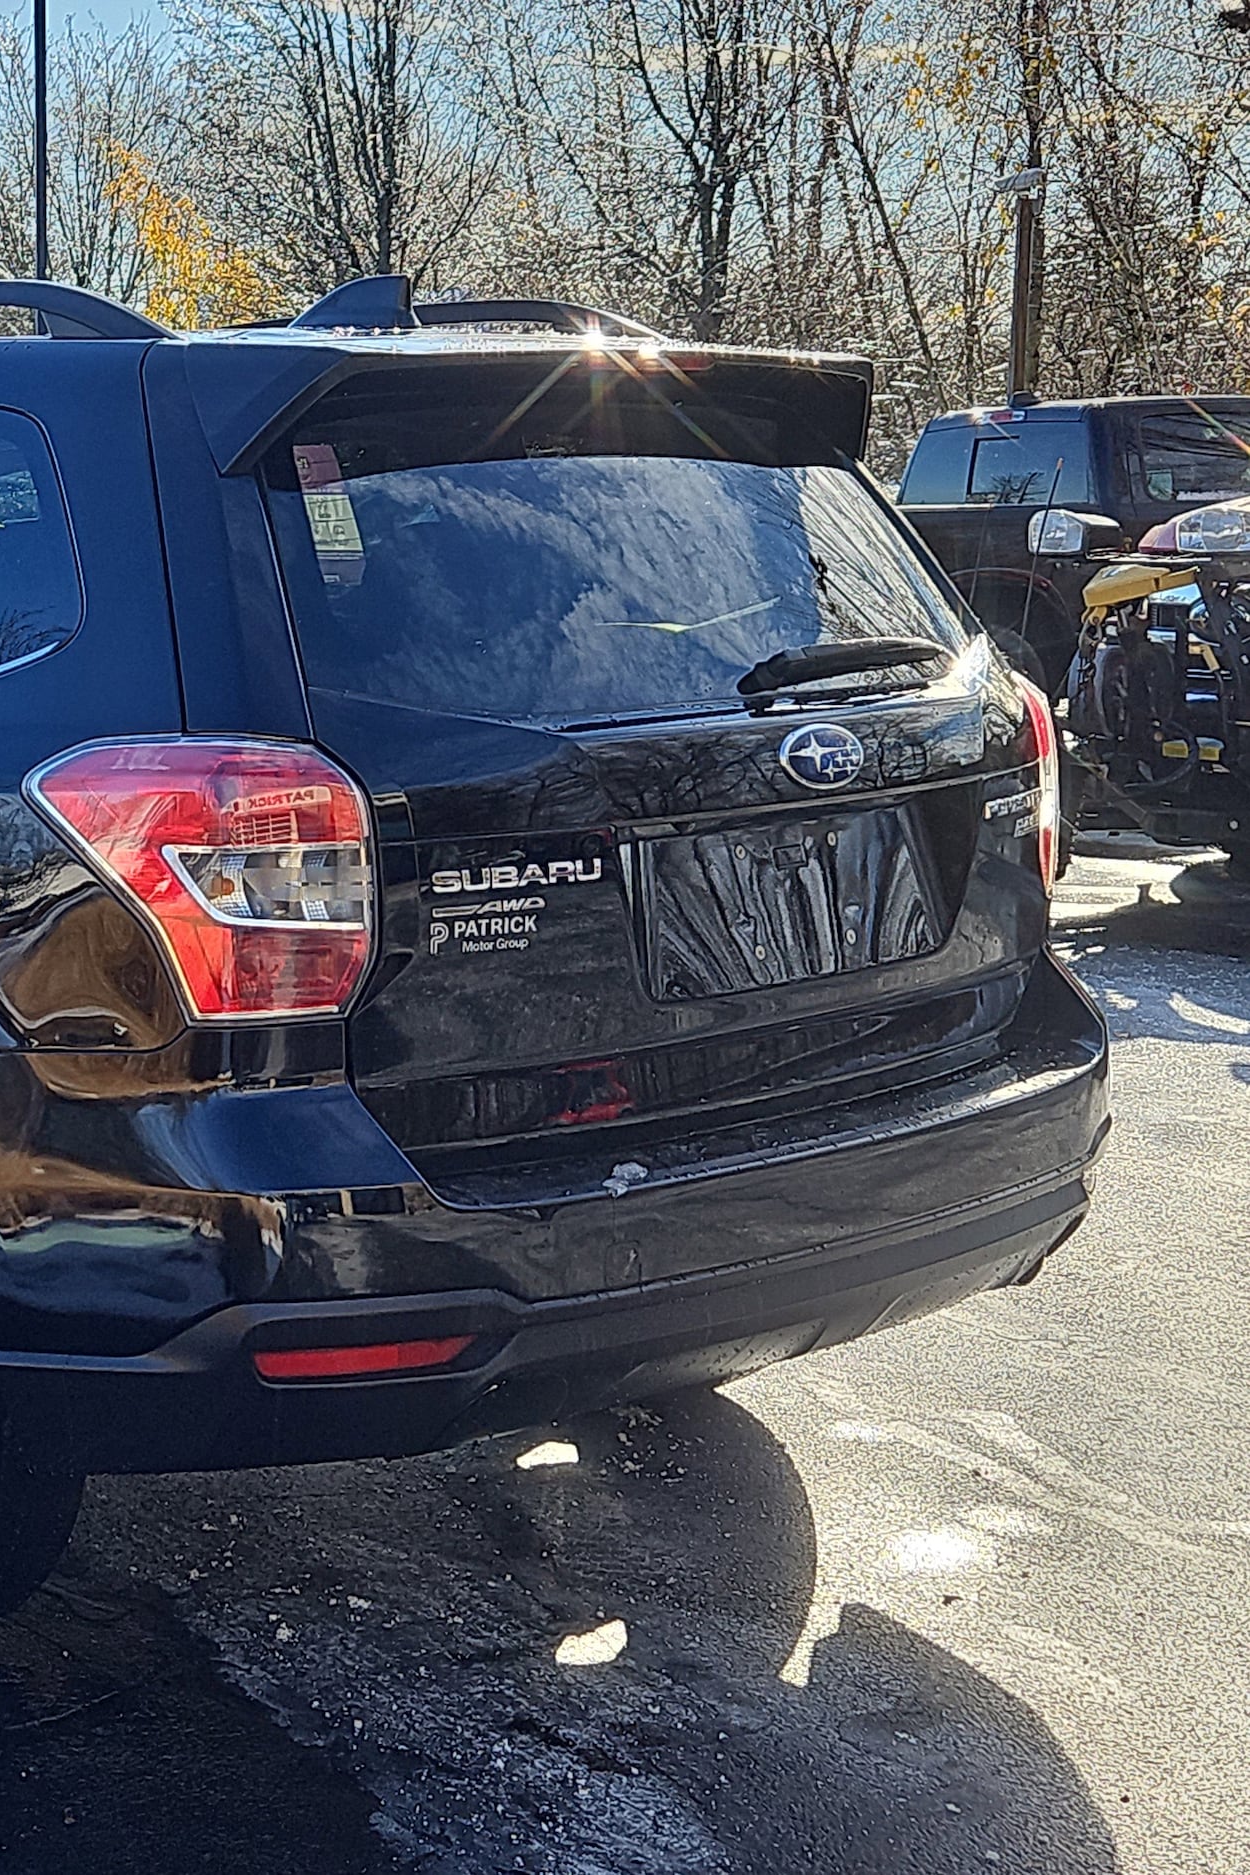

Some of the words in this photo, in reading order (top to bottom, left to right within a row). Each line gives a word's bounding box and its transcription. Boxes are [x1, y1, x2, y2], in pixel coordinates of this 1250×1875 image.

[432, 857, 602, 894] SUBARU
[476, 897, 546, 915] AWD
[453, 914, 538, 939] PATRICK
[461, 940, 495, 953] Motor
[496, 938, 530, 951] Group
